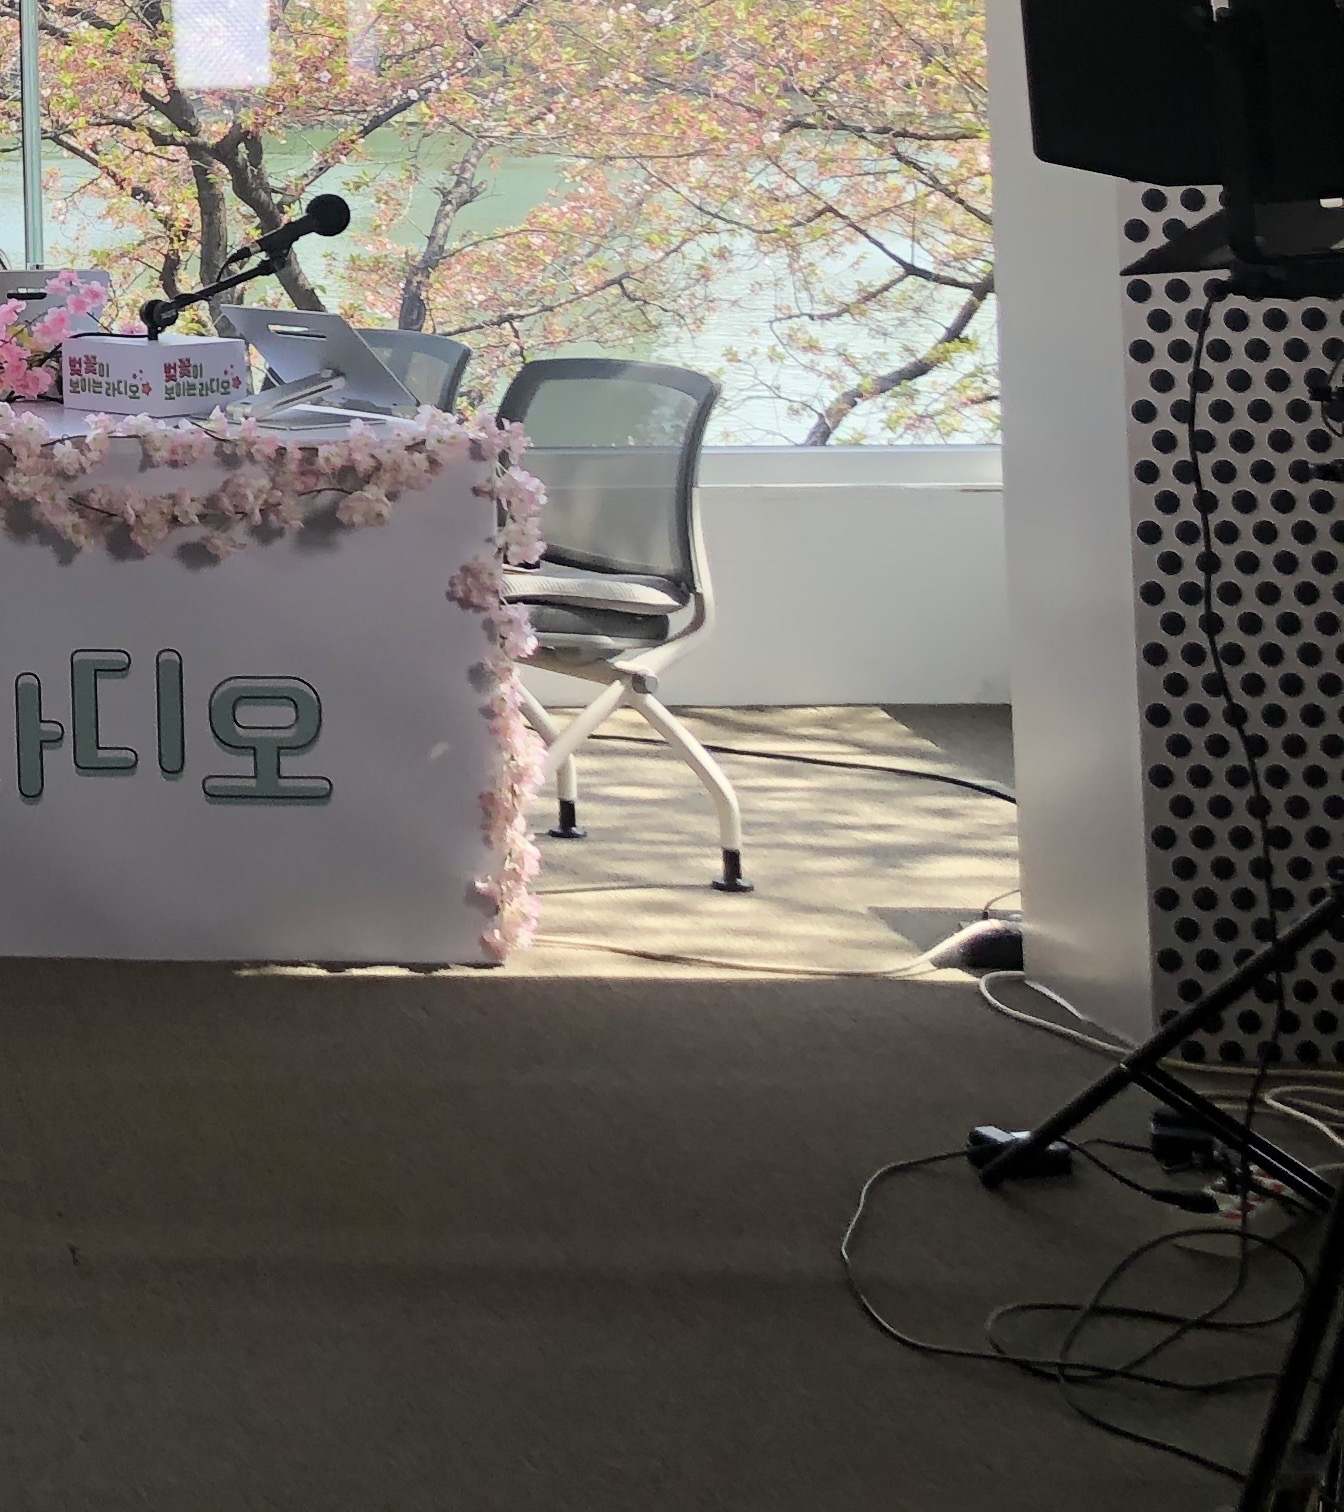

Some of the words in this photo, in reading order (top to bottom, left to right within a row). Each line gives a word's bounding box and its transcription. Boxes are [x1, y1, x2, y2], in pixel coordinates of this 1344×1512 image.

[68, 353, 110, 377] 벚꽃이
[163, 356, 204, 383] 벚꽃이
[69, 376, 104, 395] 보이는
[104, 378, 141, 400] 라디오
[164, 380, 197, 401] 보이는
[198, 377, 231, 397] 라디오
